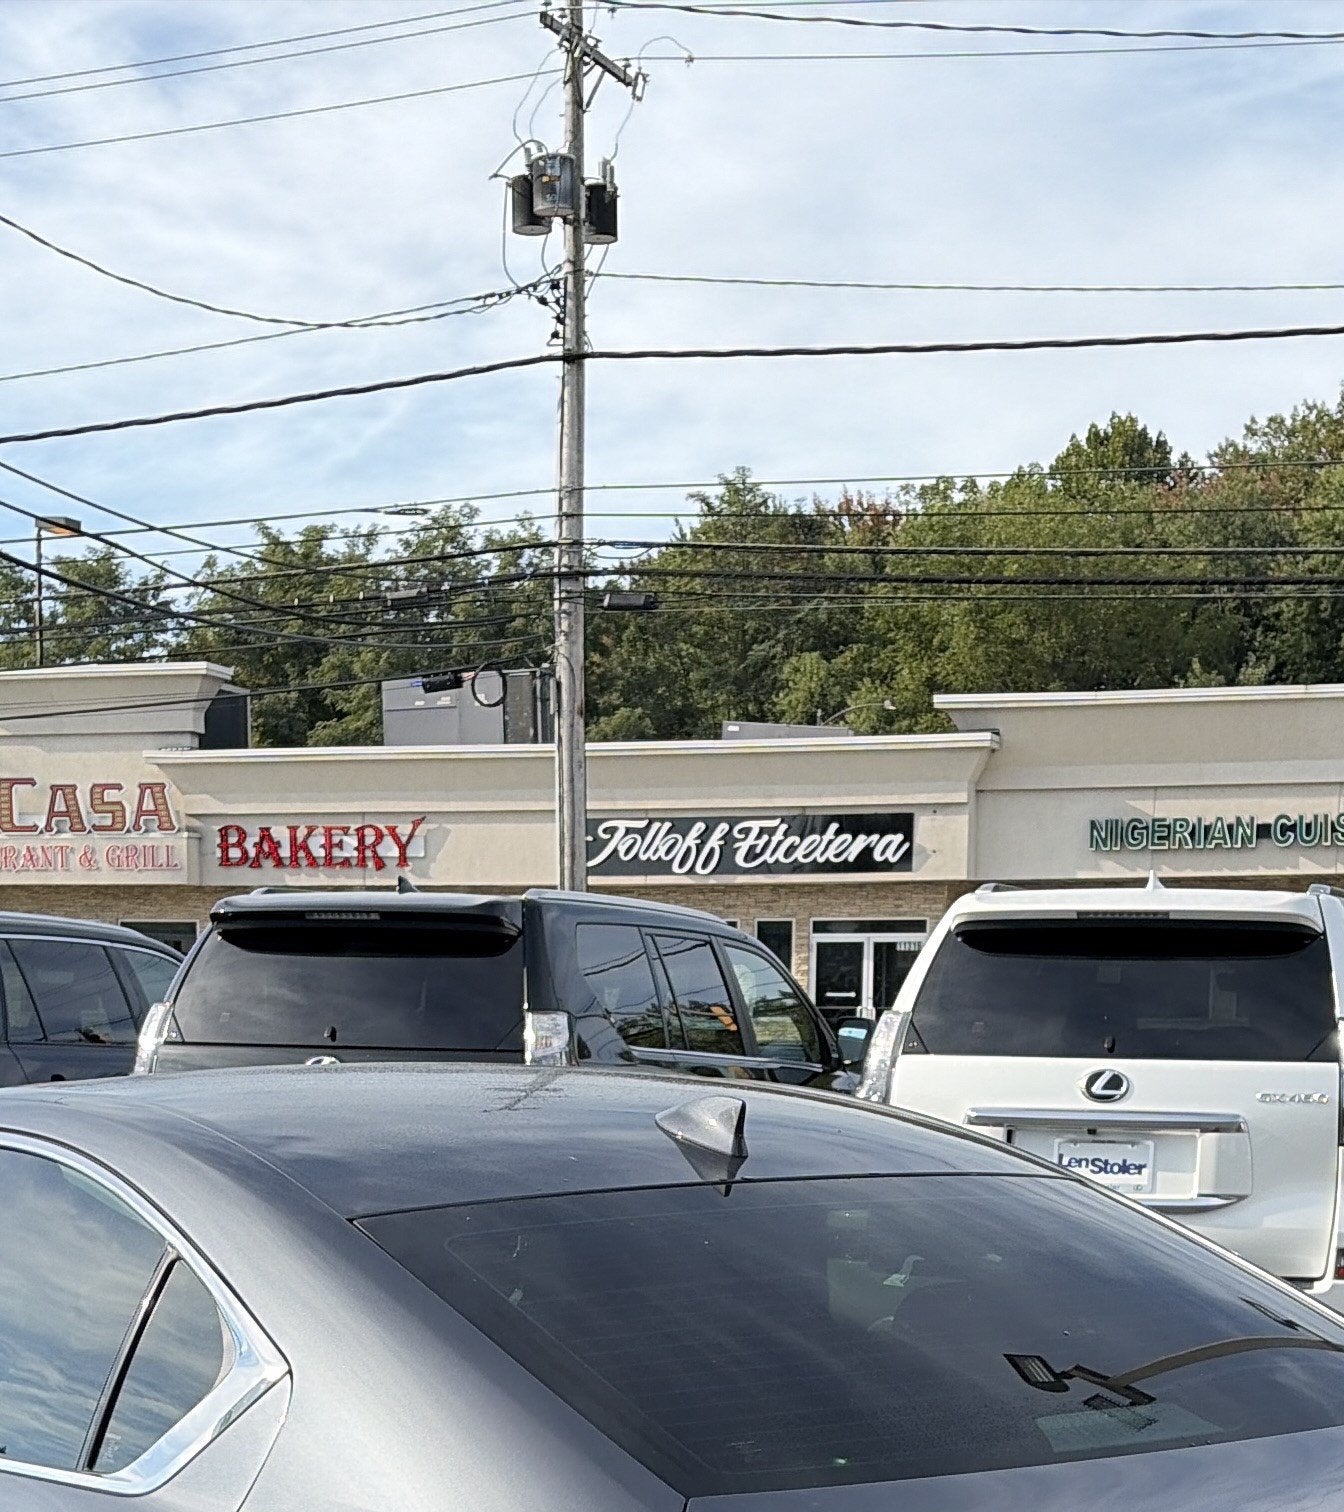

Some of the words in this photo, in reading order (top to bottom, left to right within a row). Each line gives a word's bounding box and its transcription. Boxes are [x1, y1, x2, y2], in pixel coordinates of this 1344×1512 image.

[216, 815, 427, 871] BAKERY
[732, 817, 911, 869] Etcetera
[1088, 815, 1257, 851] NIGERIAN
[78, 844, 96, 871] &
[105, 844, 180, 872] GRILL
